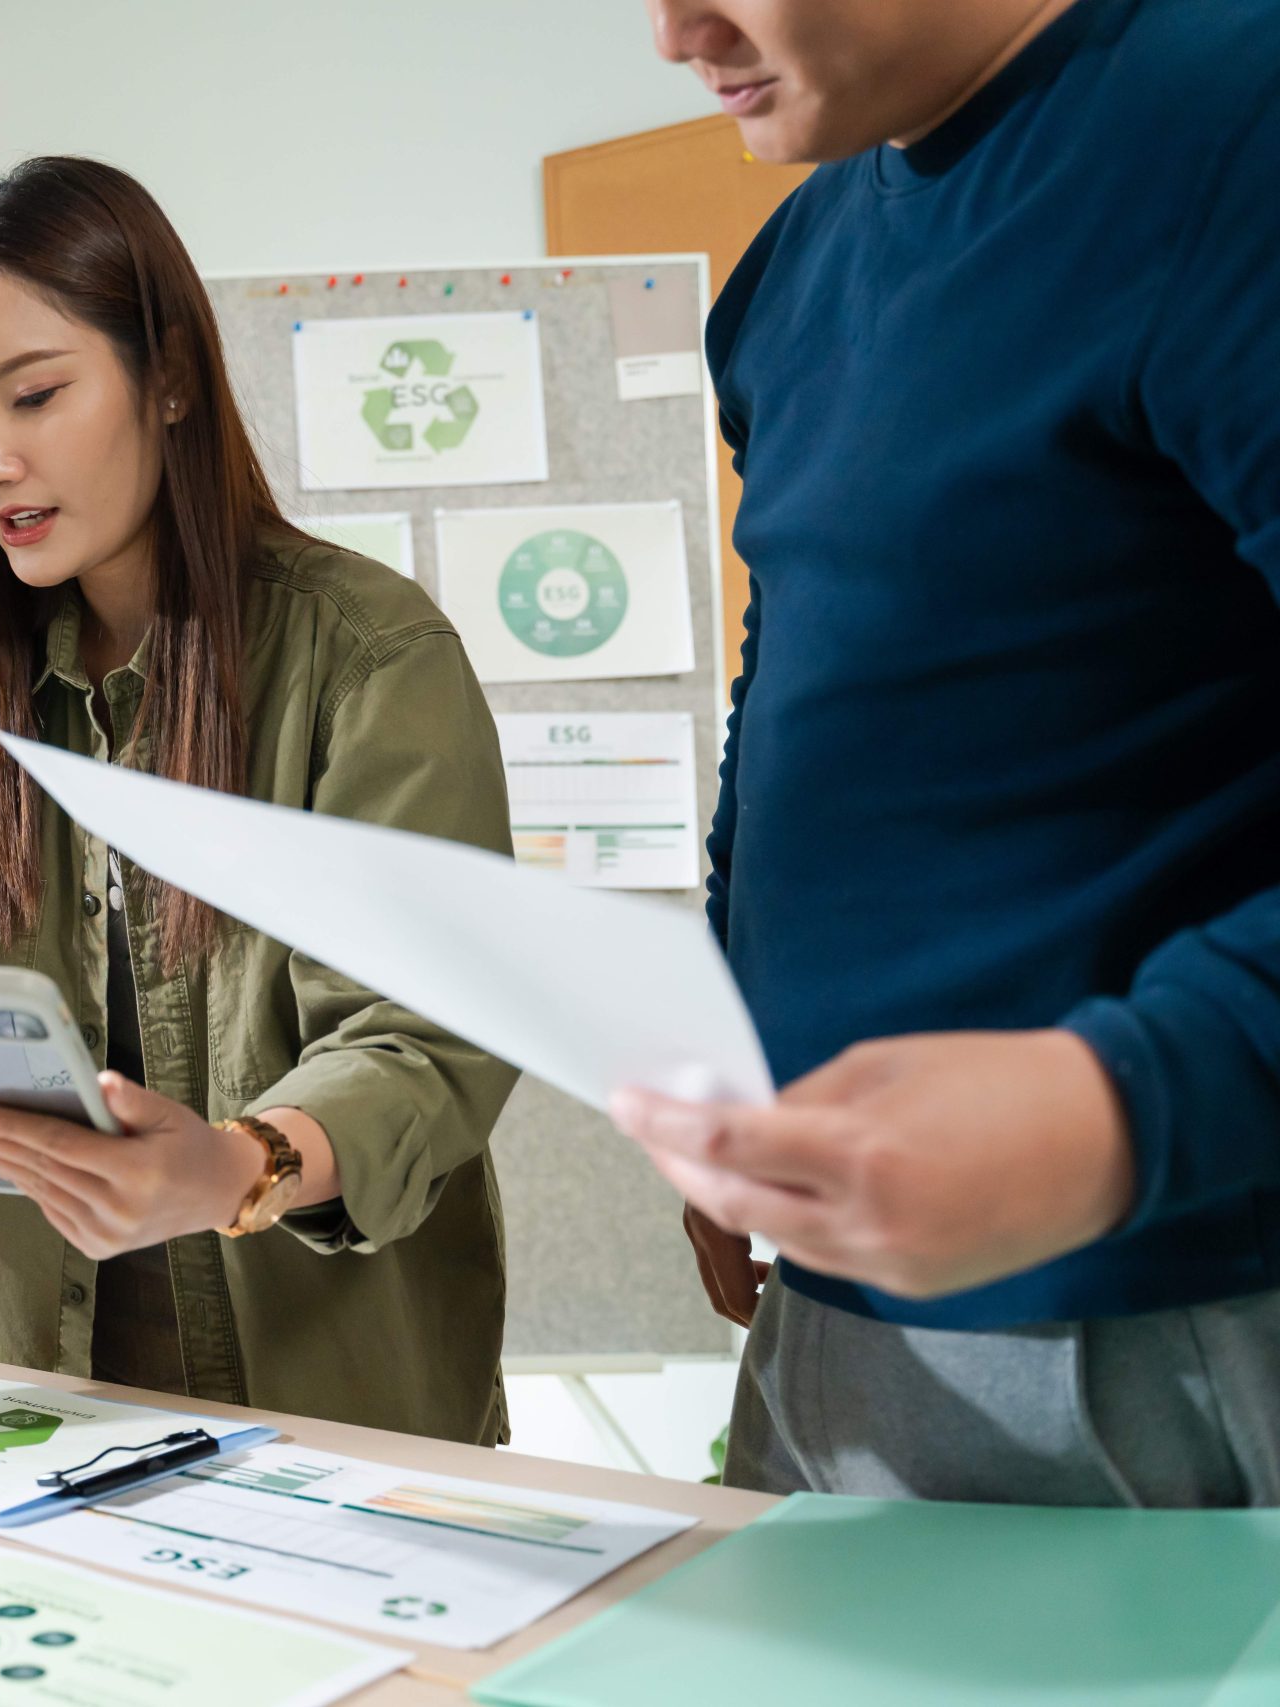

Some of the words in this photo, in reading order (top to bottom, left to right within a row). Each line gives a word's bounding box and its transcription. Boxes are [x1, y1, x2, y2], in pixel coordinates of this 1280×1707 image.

[390, 382, 451, 409] ESG
[543, 584, 581, 602] ESG
[548, 725, 592, 744] ESG
[2, 1395, 97, 1420] Environment
[141, 1547, 251, 1582] ESG
